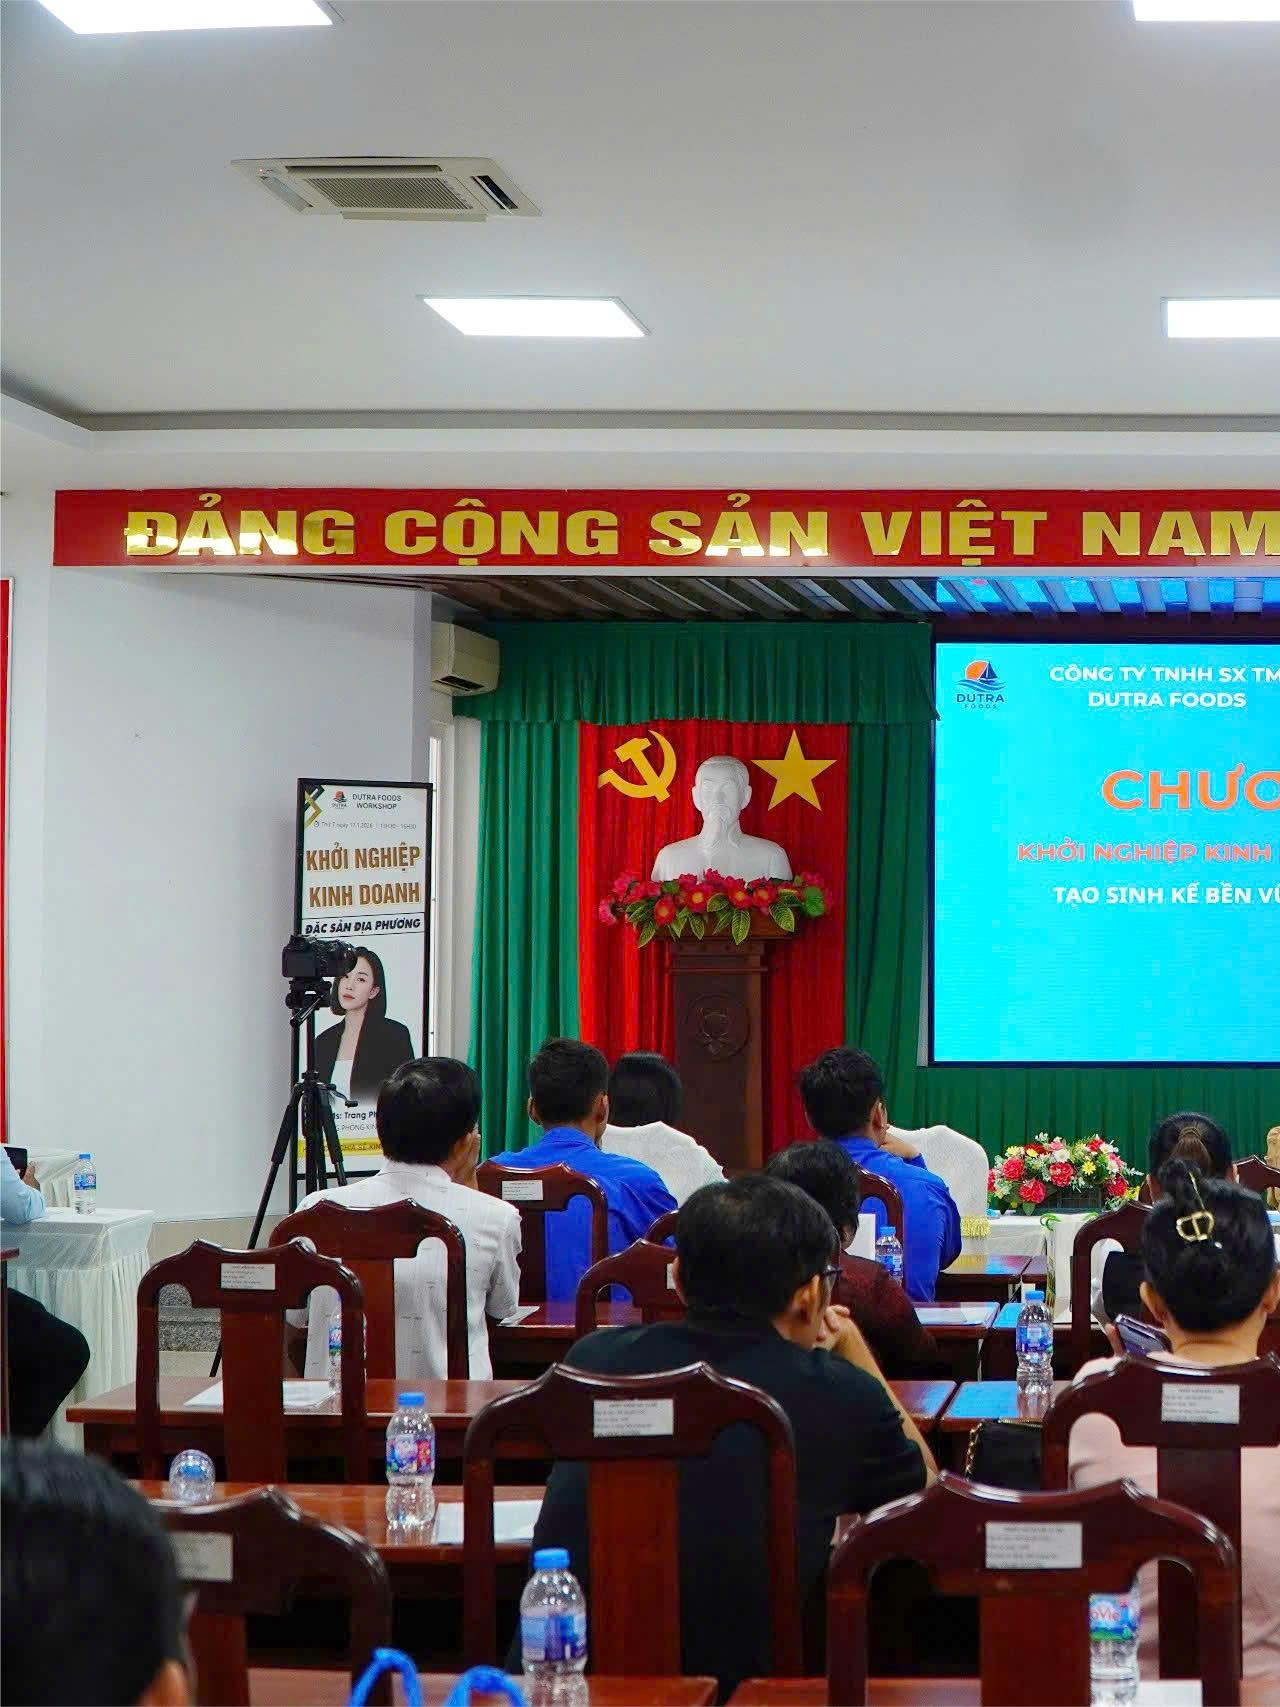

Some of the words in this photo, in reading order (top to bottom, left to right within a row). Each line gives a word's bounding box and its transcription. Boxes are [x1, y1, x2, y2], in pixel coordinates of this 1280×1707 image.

[124, 493, 355, 556] ĐẢNG
[385, 498, 619, 566] CỘNG
[648, 492, 830, 556] SẢN
[860, 498, 1047, 567] VIỆT
[1049, 663, 1114, 682] CÔNG
[1120, 667, 1146, 682] TY
[1153, 667, 1213, 682] TNHH
[1218, 667, 1247, 682] SX
[956, 693, 1005, 703] DUTRA
[1088, 692, 1165, 708] DUTRA
[1169, 692, 1247, 708] FOODS
[352, 793, 376, 801] DUTRA
[377, 794, 402, 802] FOODS
[356, 802, 398, 810] WORKSHOP
[306, 842, 349, 871] KHỞI
[355, 842, 421, 871] NGHIỆP
[1017, 837, 1085, 862] KHỞI
[1094, 839, 1198, 867] NGHIỆP
[1205, 844, 1272, 862] KINH
[309, 885, 353, 908] KINH
[359, 882, 420, 906] DOANH
[1055, 887, 1099, 908] TẠO
[1107, 887, 1163, 904] SINH
[1172, 881, 1202, 904] KẾ
[1210, 881, 1252, 904] BỀN
[305, 921, 327, 936] ĐẶC
[329, 919, 351, 932] SẢN
[354, 921, 371, 934] ĐỊA
[375, 918, 421, 931] PHƯƠNG
[344, 1112, 367, 1120] Trang
